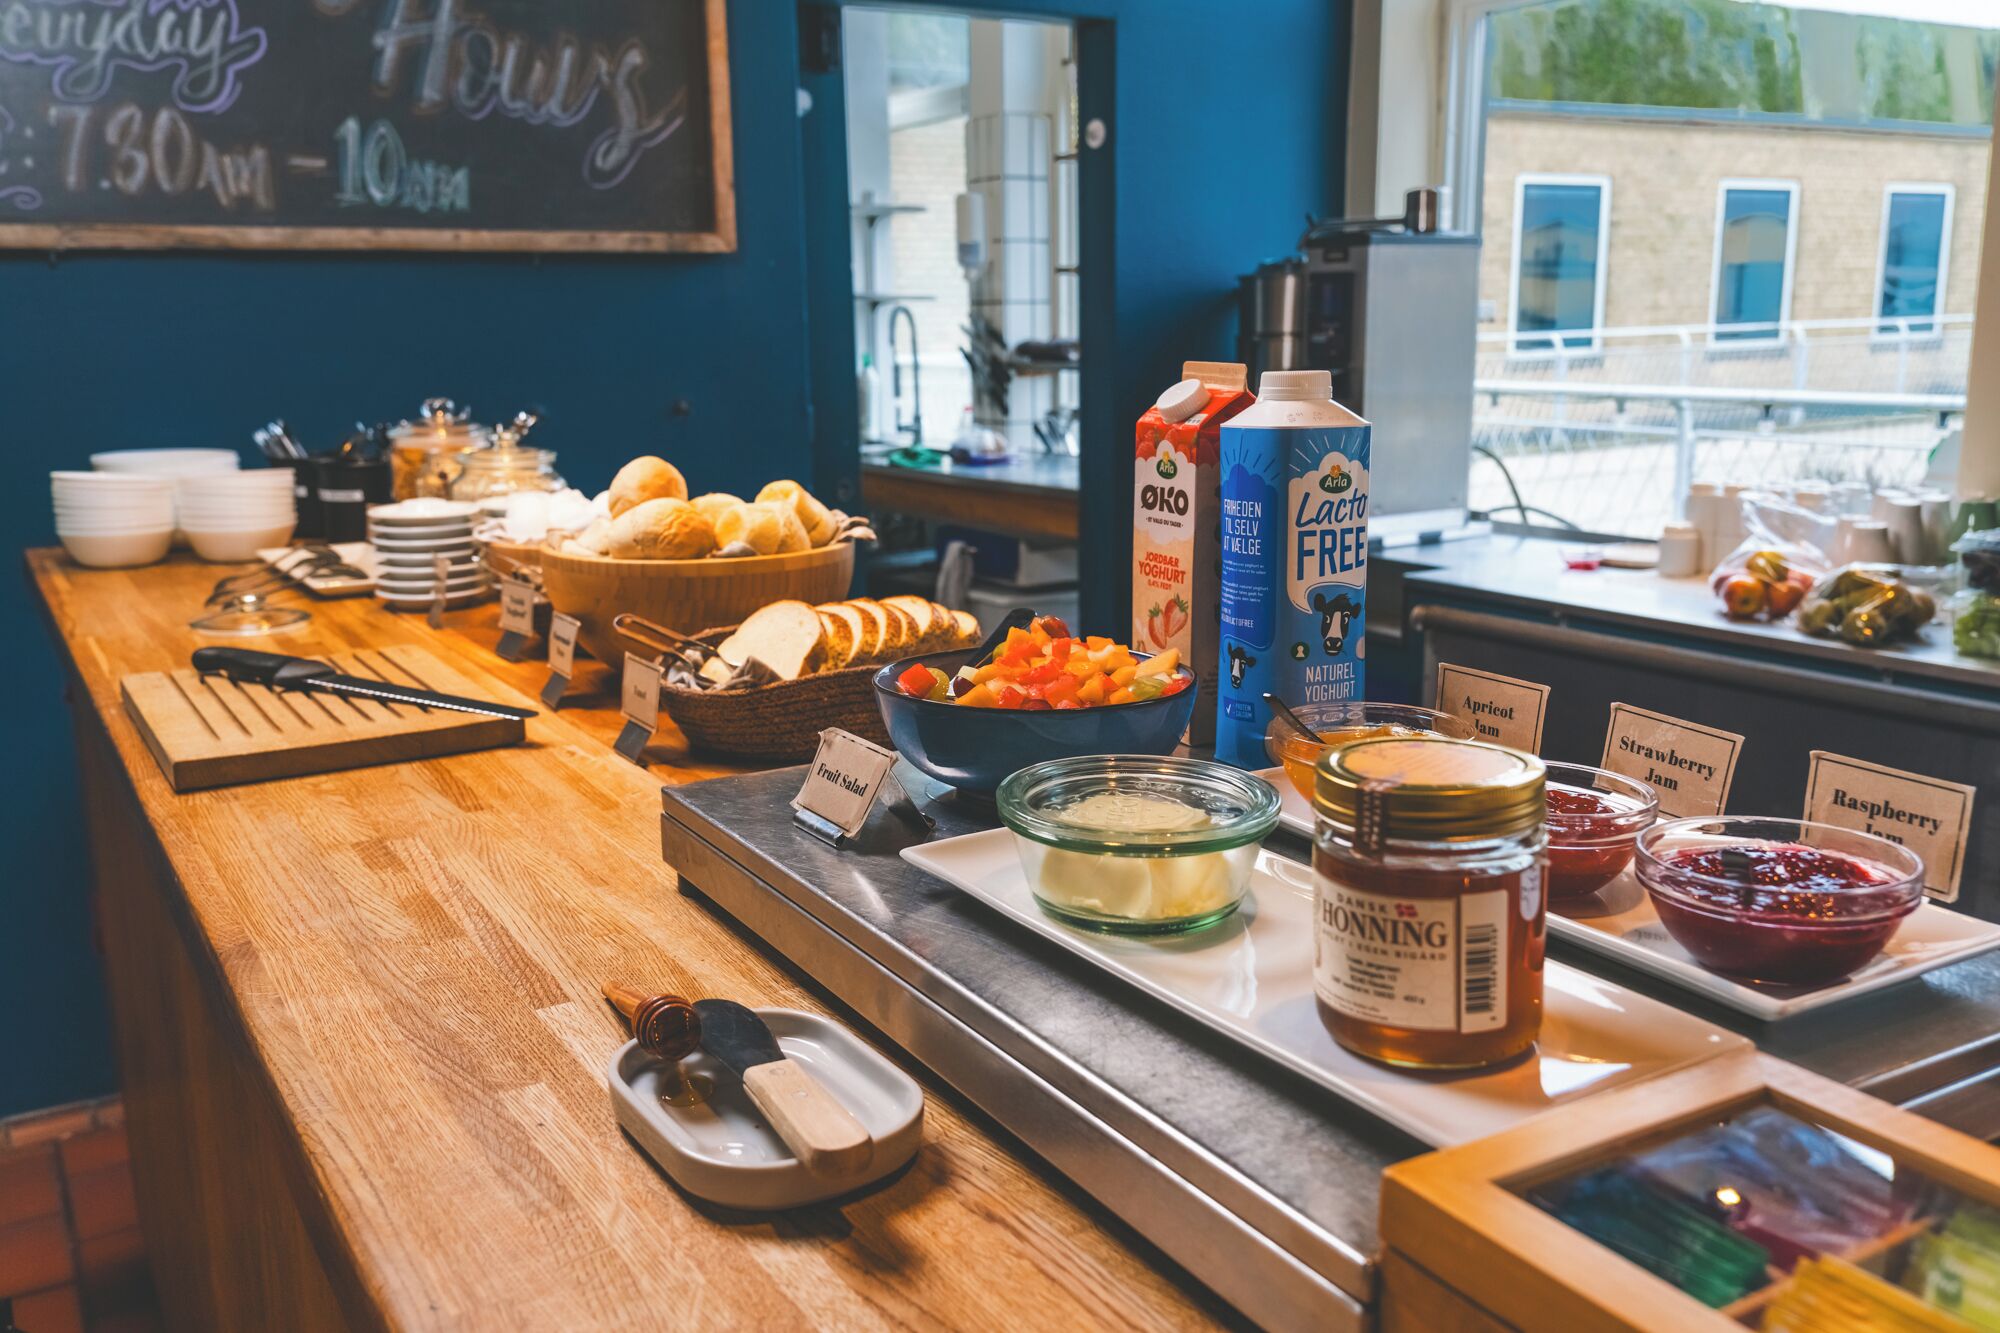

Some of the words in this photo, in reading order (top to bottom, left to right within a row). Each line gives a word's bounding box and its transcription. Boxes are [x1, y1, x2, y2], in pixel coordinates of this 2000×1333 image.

[1160, 464, 1174, 474] Arla
[1324, 476, 1348, 488] Arla
[1141, 484, 1189, 516] ØKO
[1223, 499, 1262, 518] FRIHEDEN
[1295, 487, 1368, 528] Lacto
[1225, 517, 1234, 534] TIL
[1234, 519, 1259, 536] SELV
[1145, 551, 1179, 568] JORDBÆR
[1297, 526, 1366, 581] FREE
[1138, 560, 1186, 584] YOGHURT
[1306, 661, 1356, 683] NATUREL
[1305, 680, 1356, 702] YOGHURT
[1462, 695, 1514, 720] Apricot
[1474, 718, 1500, 737] Jam
[1619, 735, 1717, 781] Strawberry
[817, 762, 841, 785] Fruit
[839, 774, 869, 797] Salad
[1644, 768, 1679, 791] Jam
[1832, 788, 1943, 836] Raspberry
[1336, 892, 1388, 914] DANSK
[1322, 898, 1448, 948] HONNING
